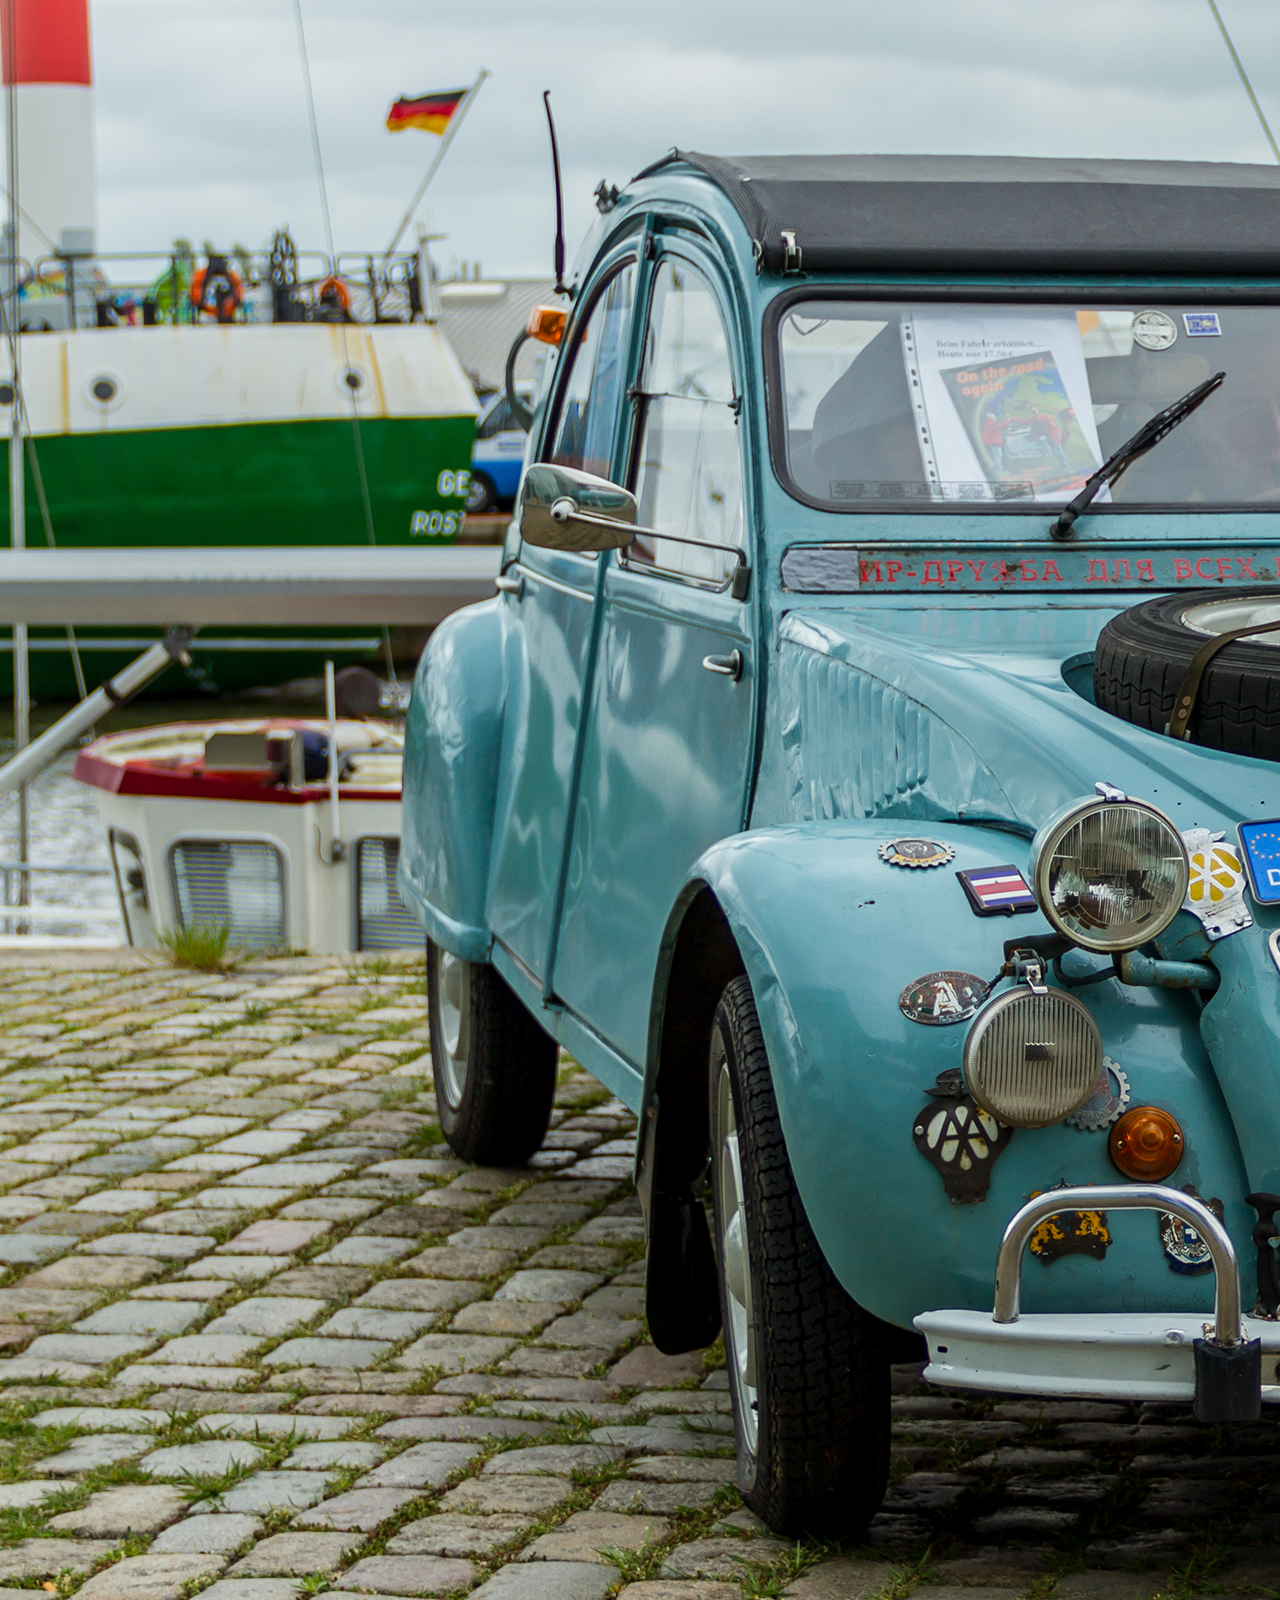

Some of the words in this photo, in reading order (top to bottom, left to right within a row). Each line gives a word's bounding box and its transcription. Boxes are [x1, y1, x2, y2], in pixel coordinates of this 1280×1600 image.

[936, 340, 959, 348] Beim
[956, 370, 978, 384] On
[981, 365, 1007, 380] the
[1010, 357, 1045, 376] road
[961, 380, 1004, 399] again
[1084, 557, 1156, 583] ДЛЯ
[1173, 556, 1258, 581] ВСЕХ
